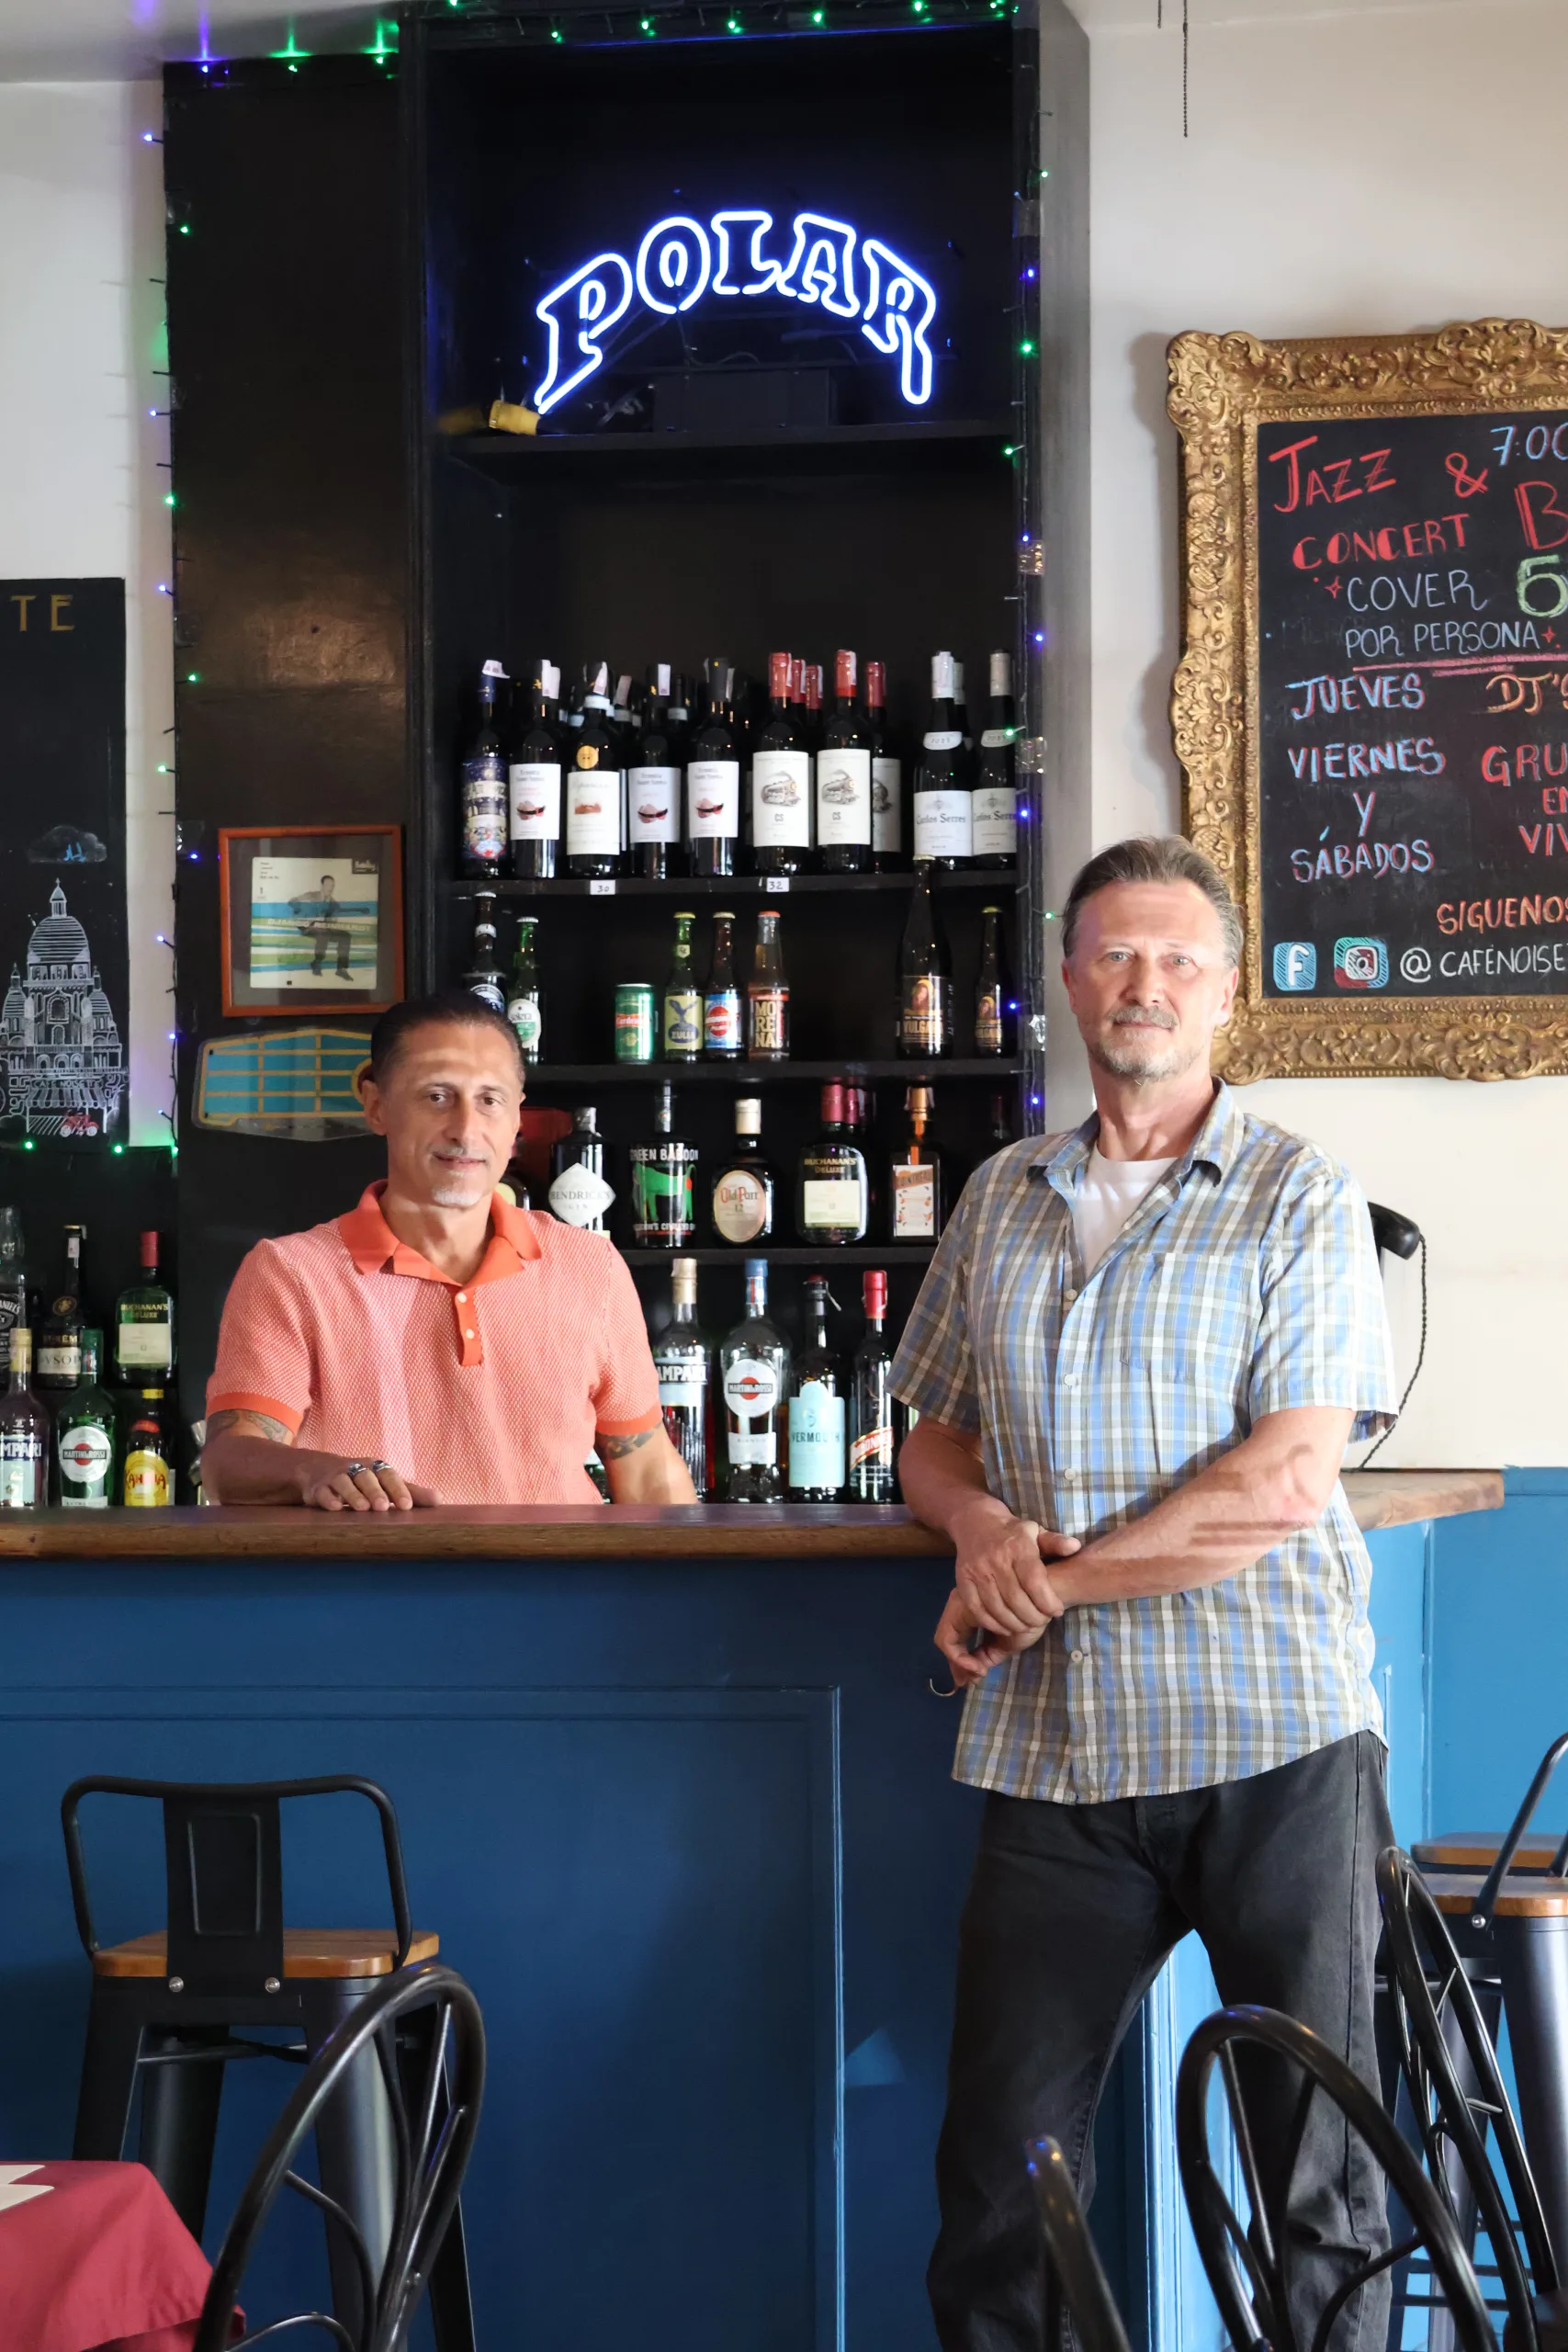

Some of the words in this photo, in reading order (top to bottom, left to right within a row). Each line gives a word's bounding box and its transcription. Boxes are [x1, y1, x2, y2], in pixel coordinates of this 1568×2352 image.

[534, 210, 937, 414] POLAR
[1269, 435, 1396, 512] JAZZ
[1446, 452, 1488, 498] &
[1292, 514, 1469, 570] CONCERT
[1348, 570, 1488, 612] COVER
[1345, 625, 1404, 658] POR
[1414, 620, 1540, 655] PERSONA
[1286, 672, 1425, 720] JUEVES
[1288, 737, 1446, 782] VIERNES
[1352, 791, 1376, 837] Y
[1291, 827, 1435, 883] SÁBADOS
[769, 880, 782, 889] 32
